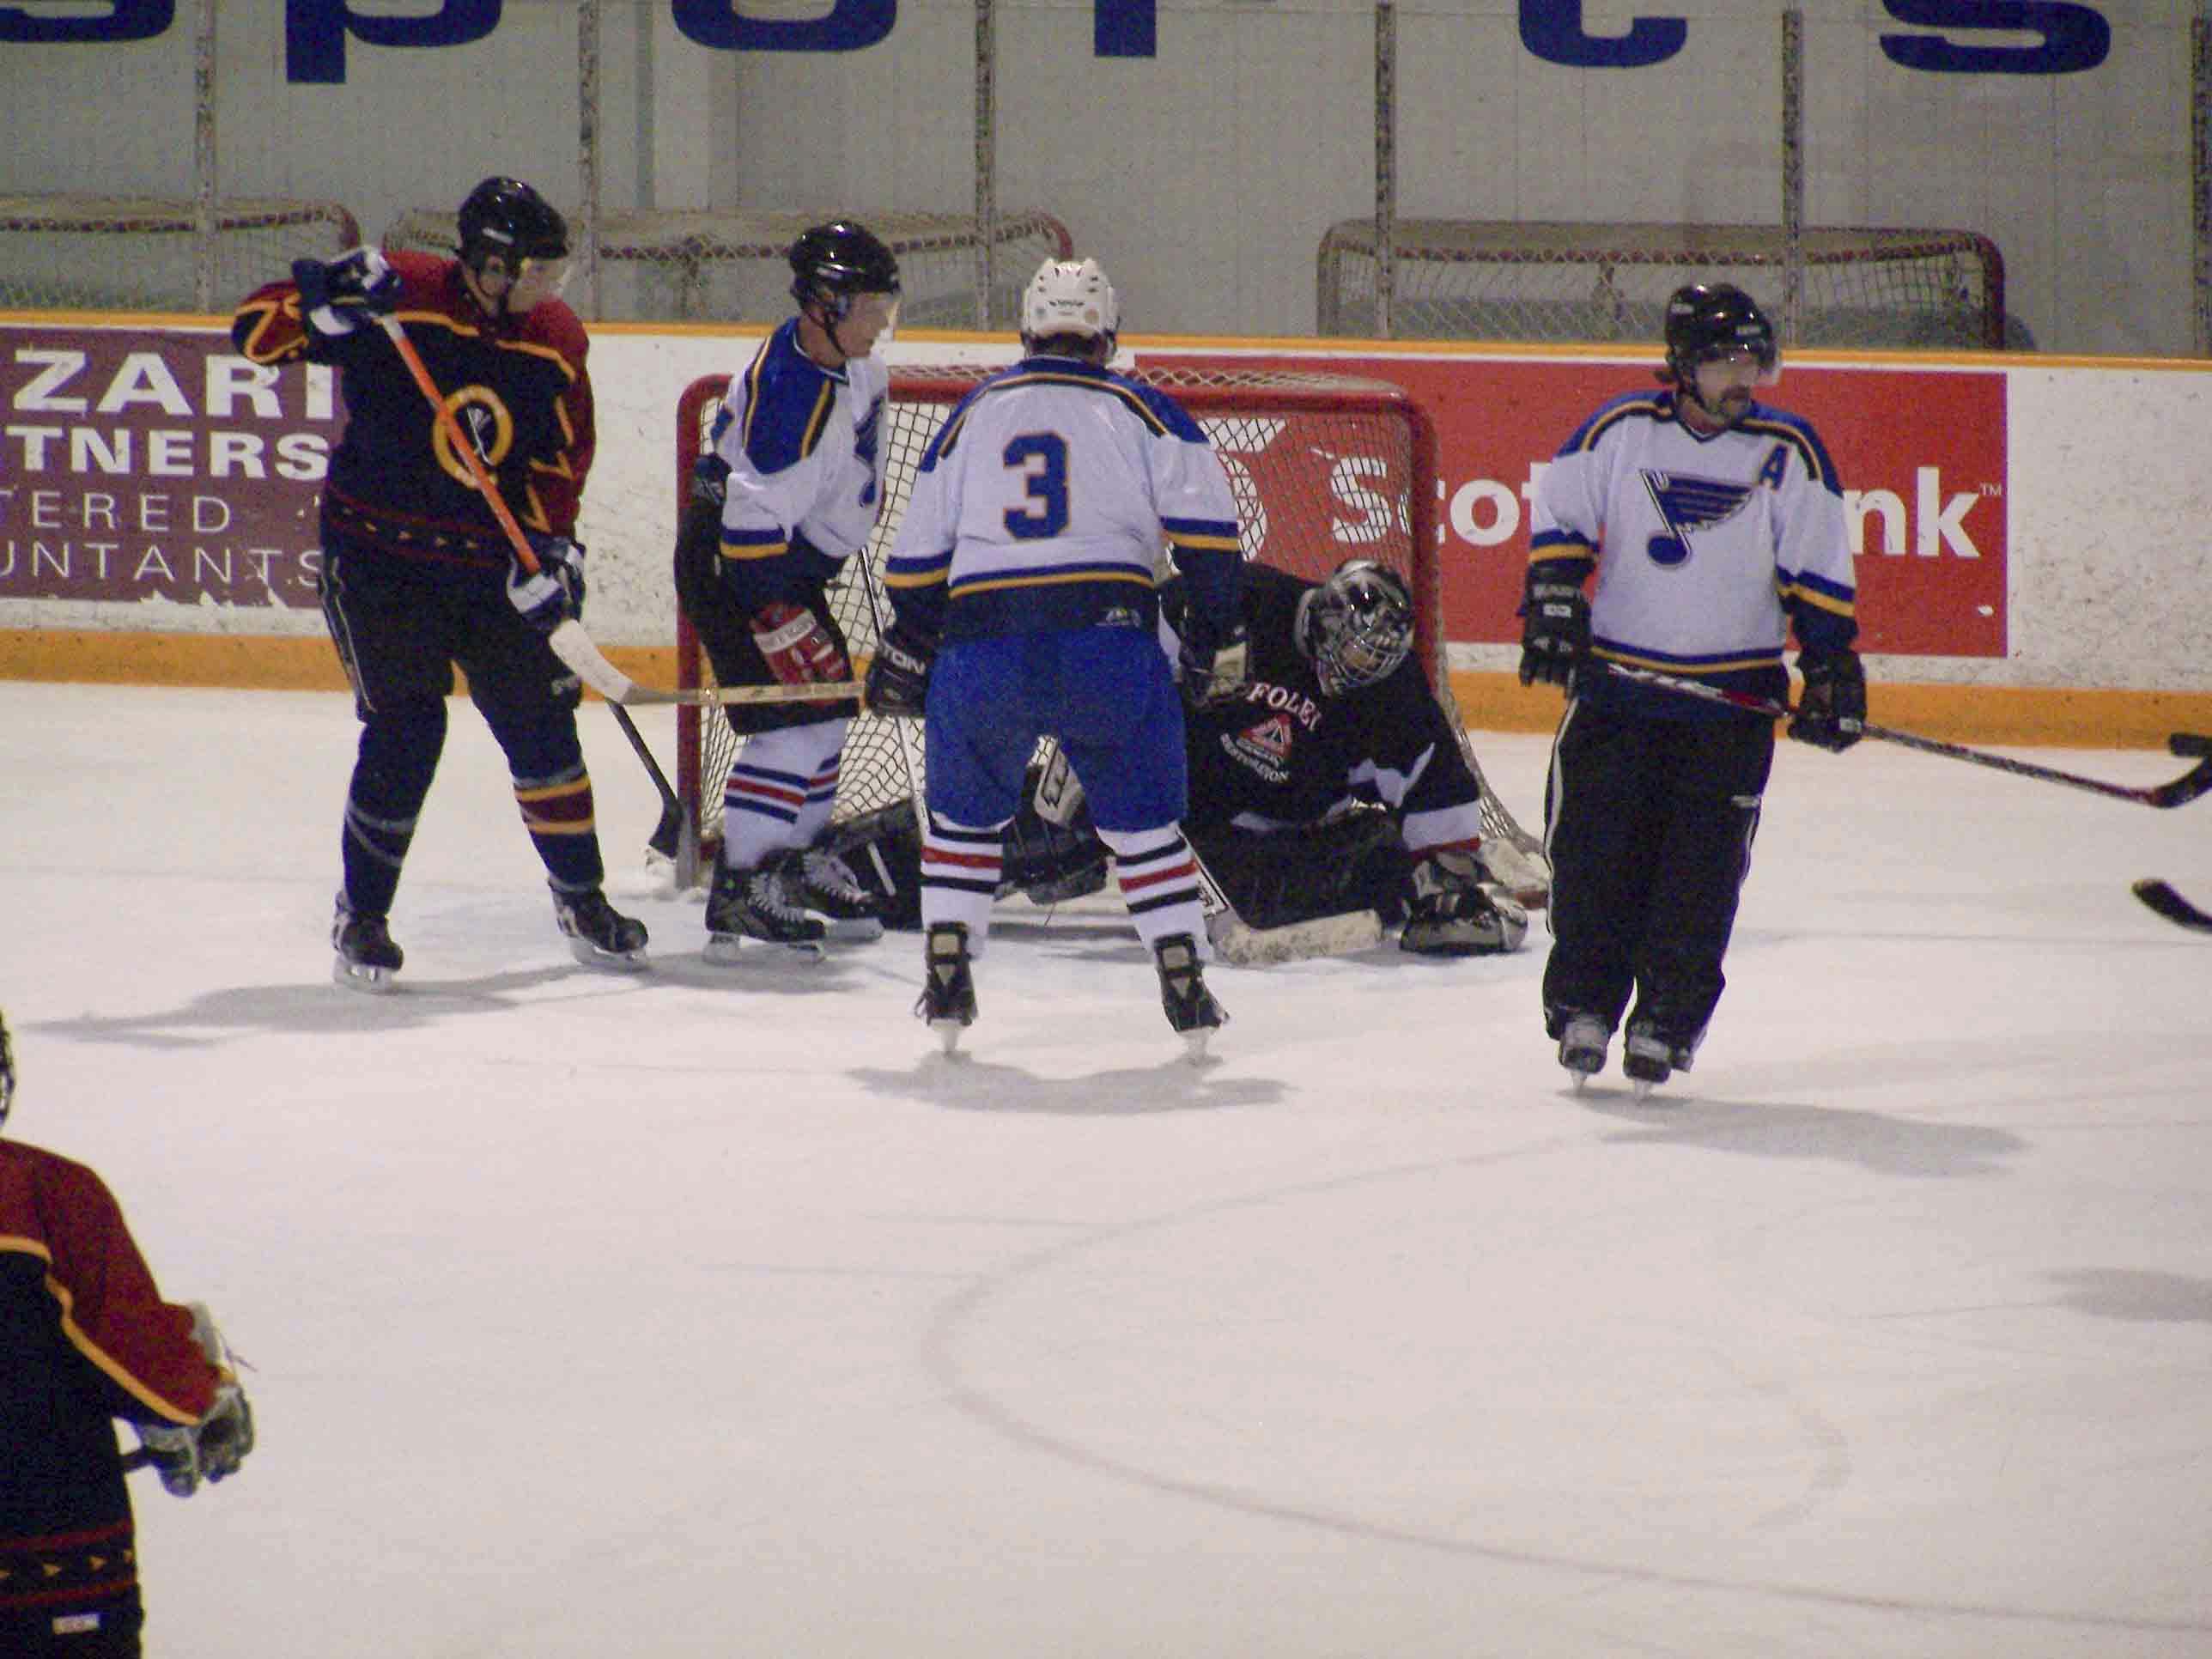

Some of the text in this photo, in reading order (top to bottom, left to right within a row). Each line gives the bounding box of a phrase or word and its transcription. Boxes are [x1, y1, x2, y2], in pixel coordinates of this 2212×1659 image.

[6, 425, 331, 481] TNERS
[1758, 441, 1790, 491] A
[1002, 430, 1072, 540] 3
